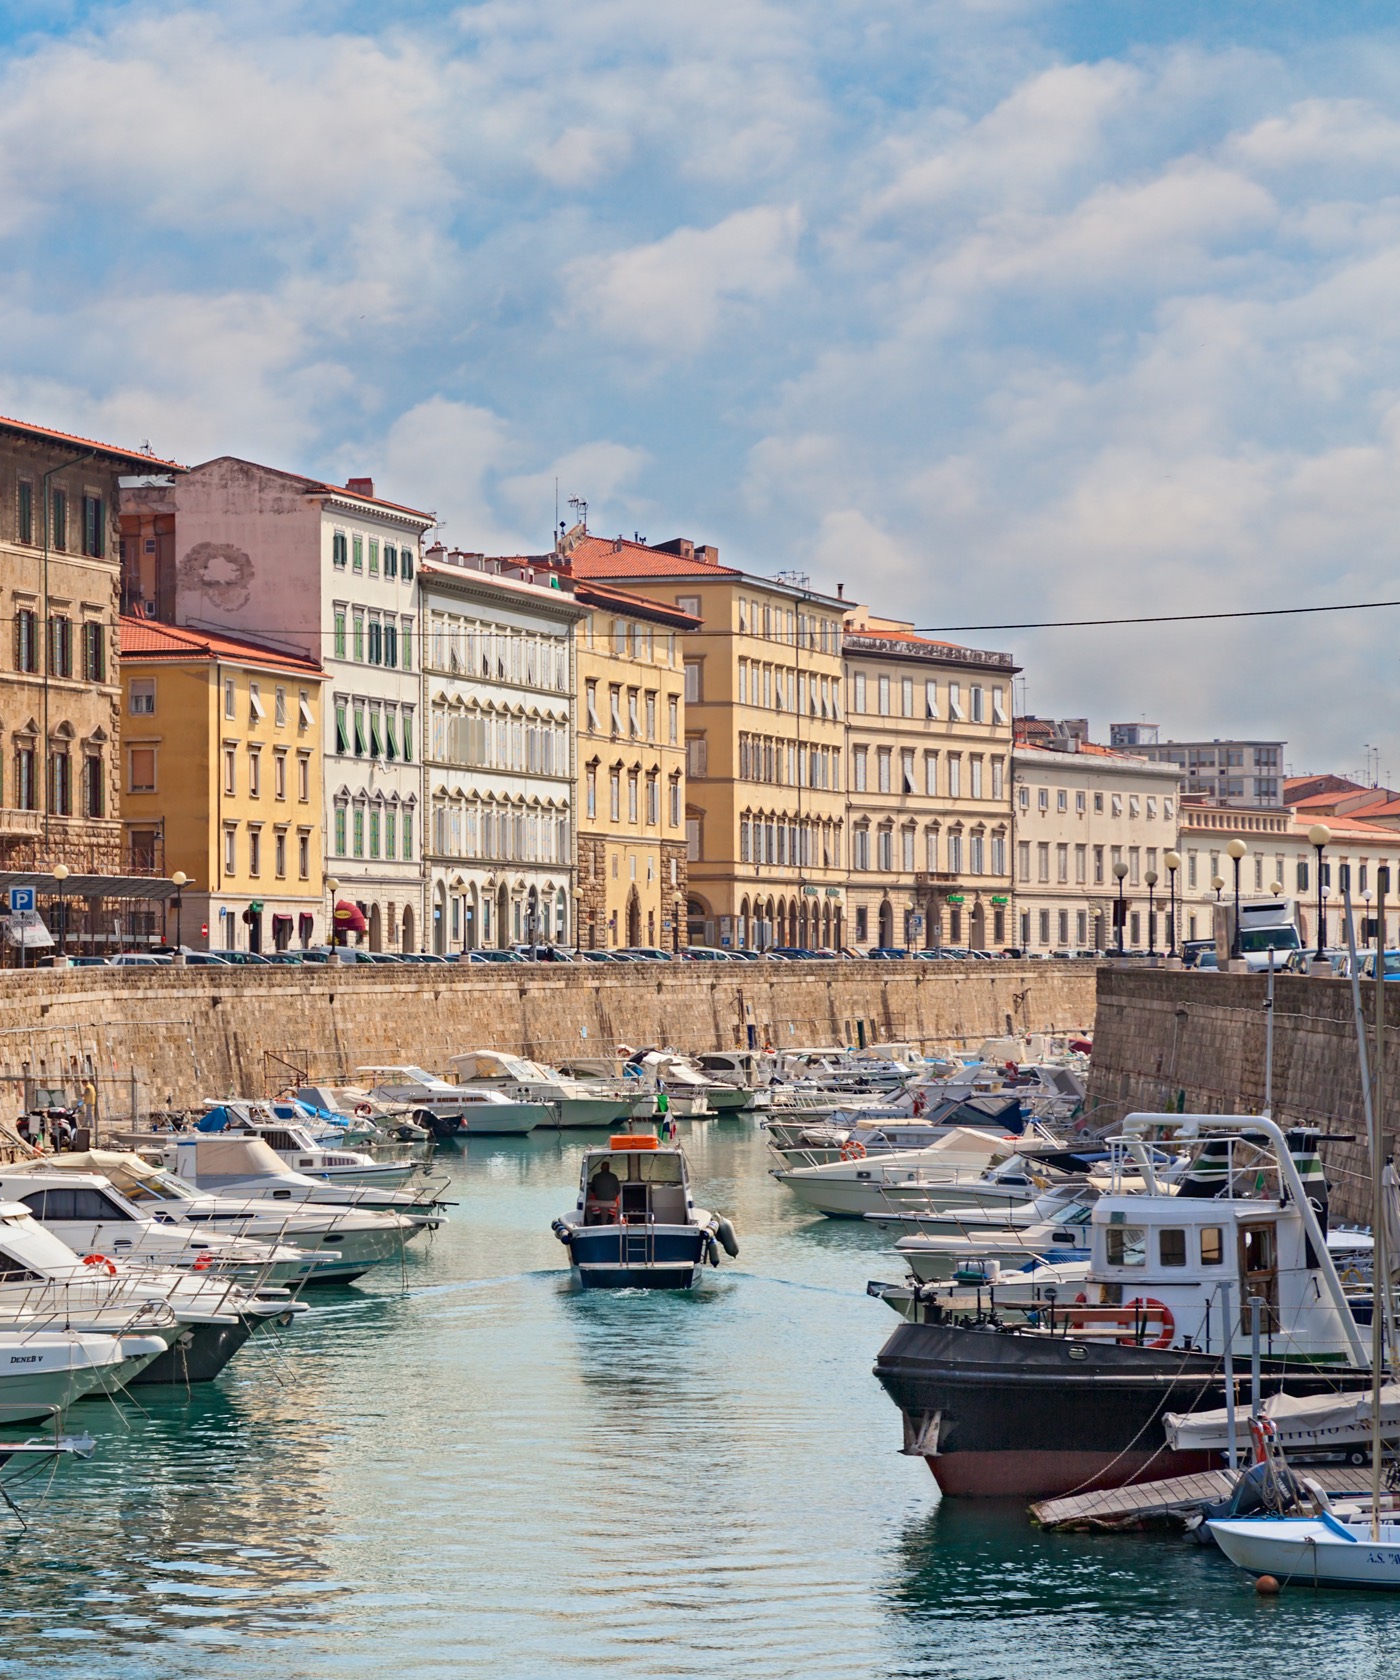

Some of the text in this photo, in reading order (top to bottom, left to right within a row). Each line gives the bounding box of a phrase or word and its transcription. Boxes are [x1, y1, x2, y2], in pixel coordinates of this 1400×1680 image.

[16, 893, 28, 908] P
[37, 1355, 44, 1363] V
[1277, 1477, 1291, 1499] YAMAHA
[1366, 1552, 1385, 1564] A.S.
